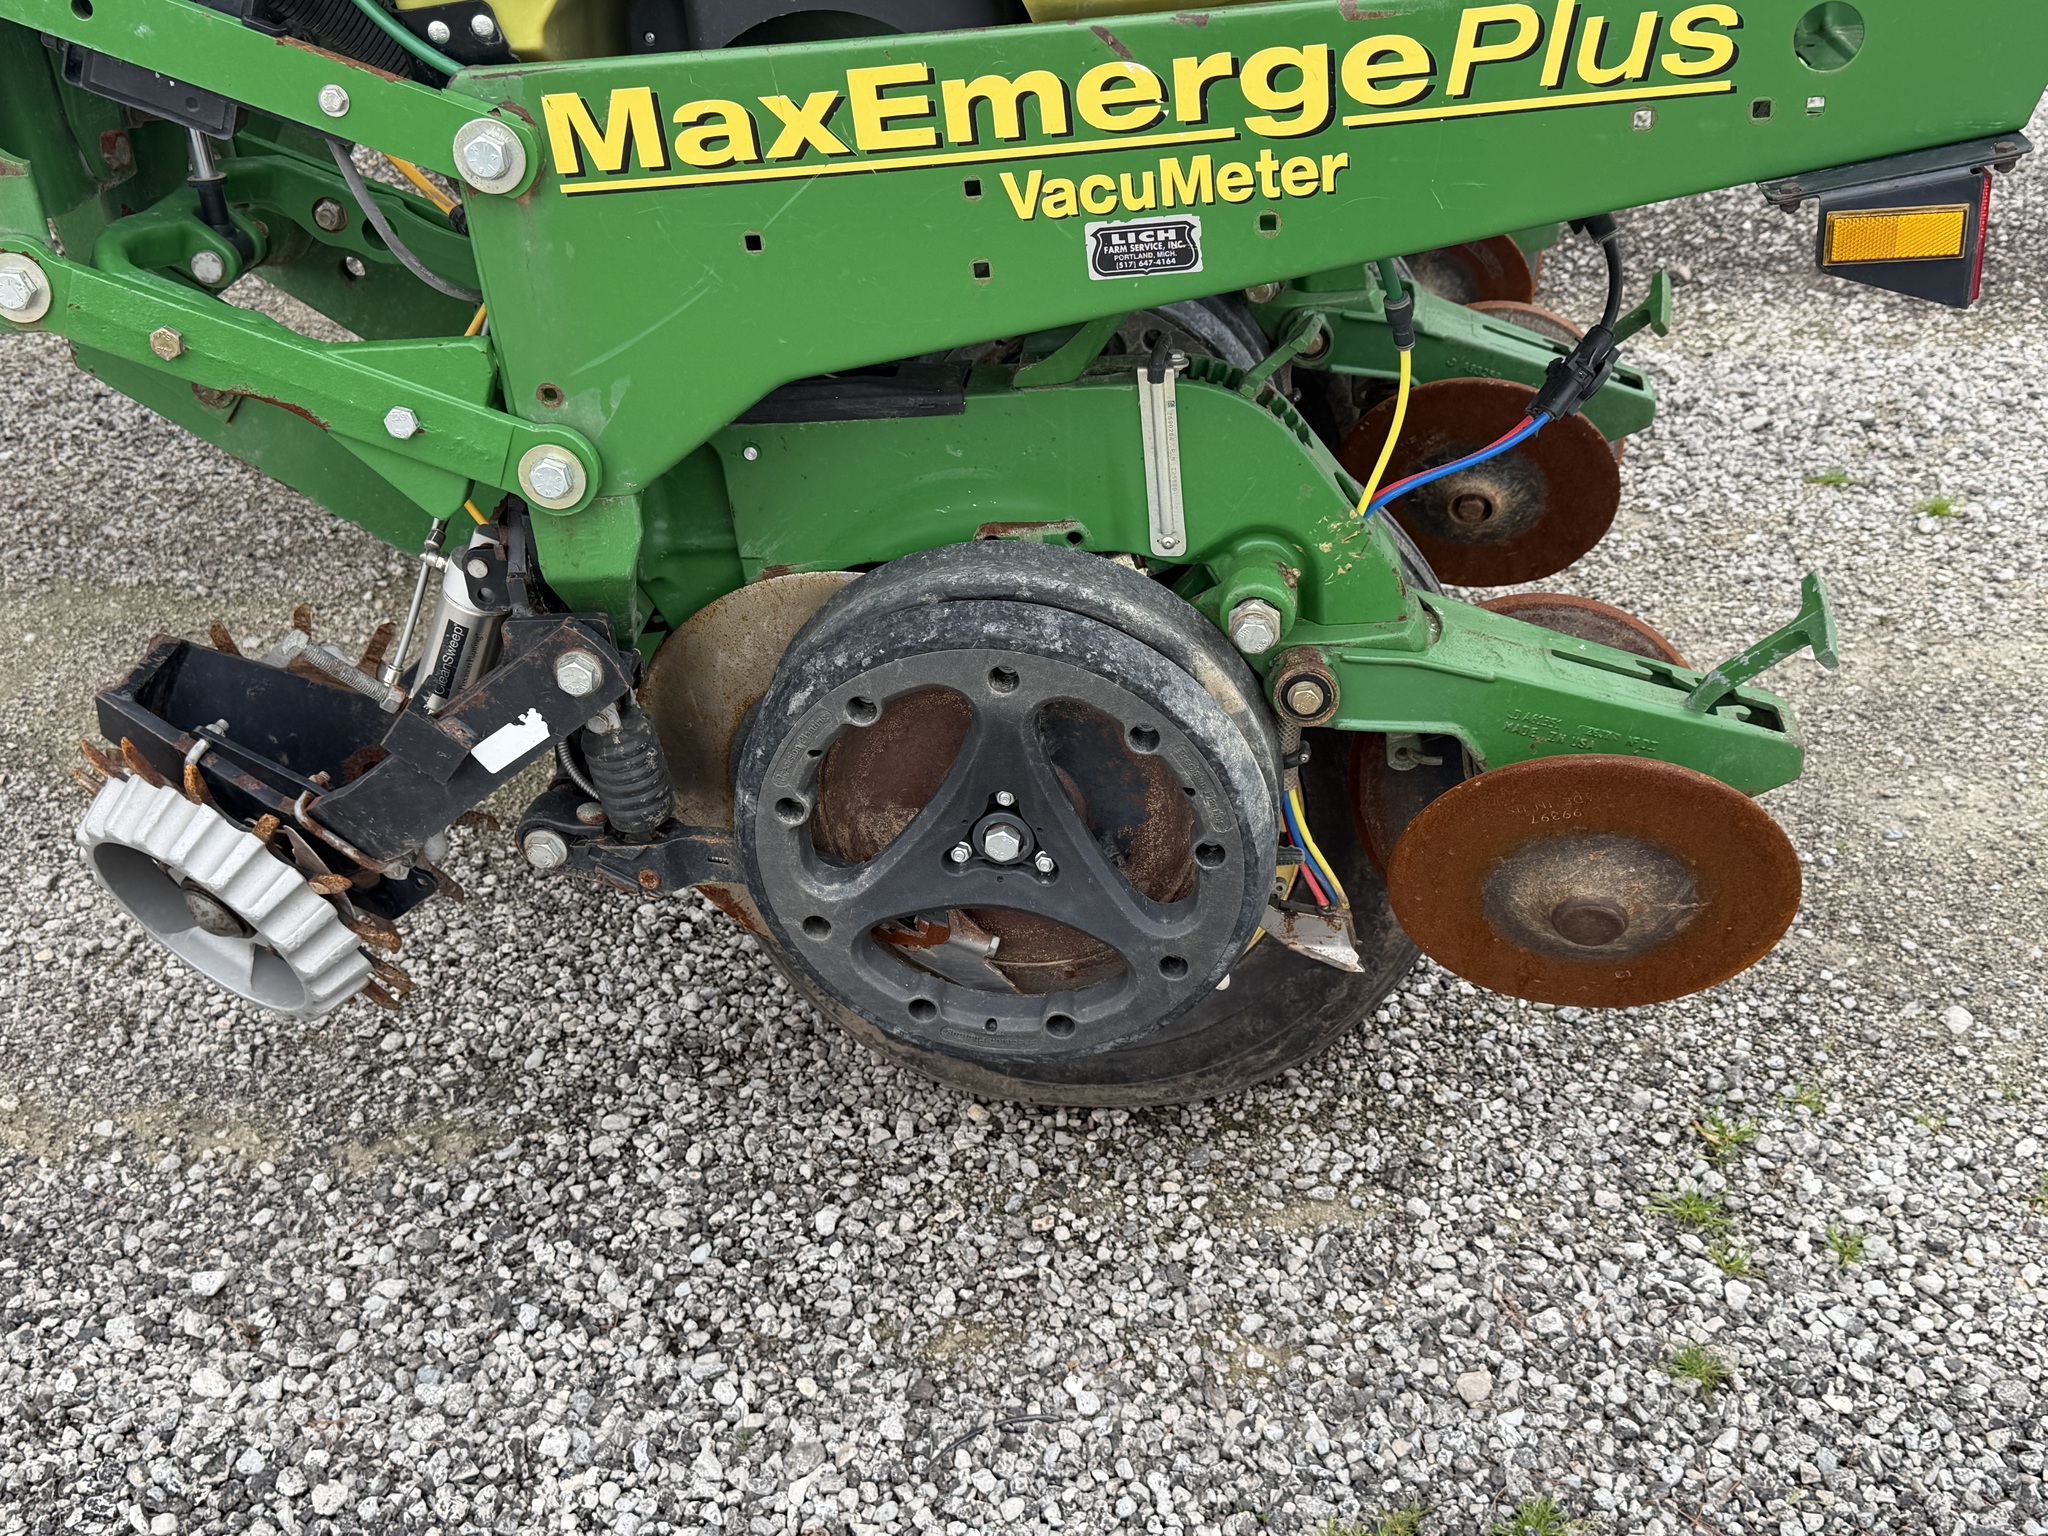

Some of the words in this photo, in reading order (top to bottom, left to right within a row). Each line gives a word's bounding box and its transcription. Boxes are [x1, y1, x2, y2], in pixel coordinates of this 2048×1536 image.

[1002, 150, 1348, 221] VacuMeter
[1111, 228, 1177, 245] LICH
[1103, 245, 1128, 255] FARM
[1130, 241, 1166, 254] SERVICE,
[1168, 240, 1186, 250] INC.
[1113, 252, 1156, 262] PORTLAND,
[1156, 250, 1178, 259] MICH.
[1115, 260, 1137, 271] (517)
[1138, 258, 1177, 268] 647-4164
[1503, 720, 1539, 738] MADE
[1545, 730, 1567, 744] IN
[1570, 735, 1595, 751] USA
[774, 744, 806, 782] Precision
[796, 711, 831, 749] Planting
[1175, 745, 1211, 790] Precision
[1530, 808, 1583, 825] 99397
